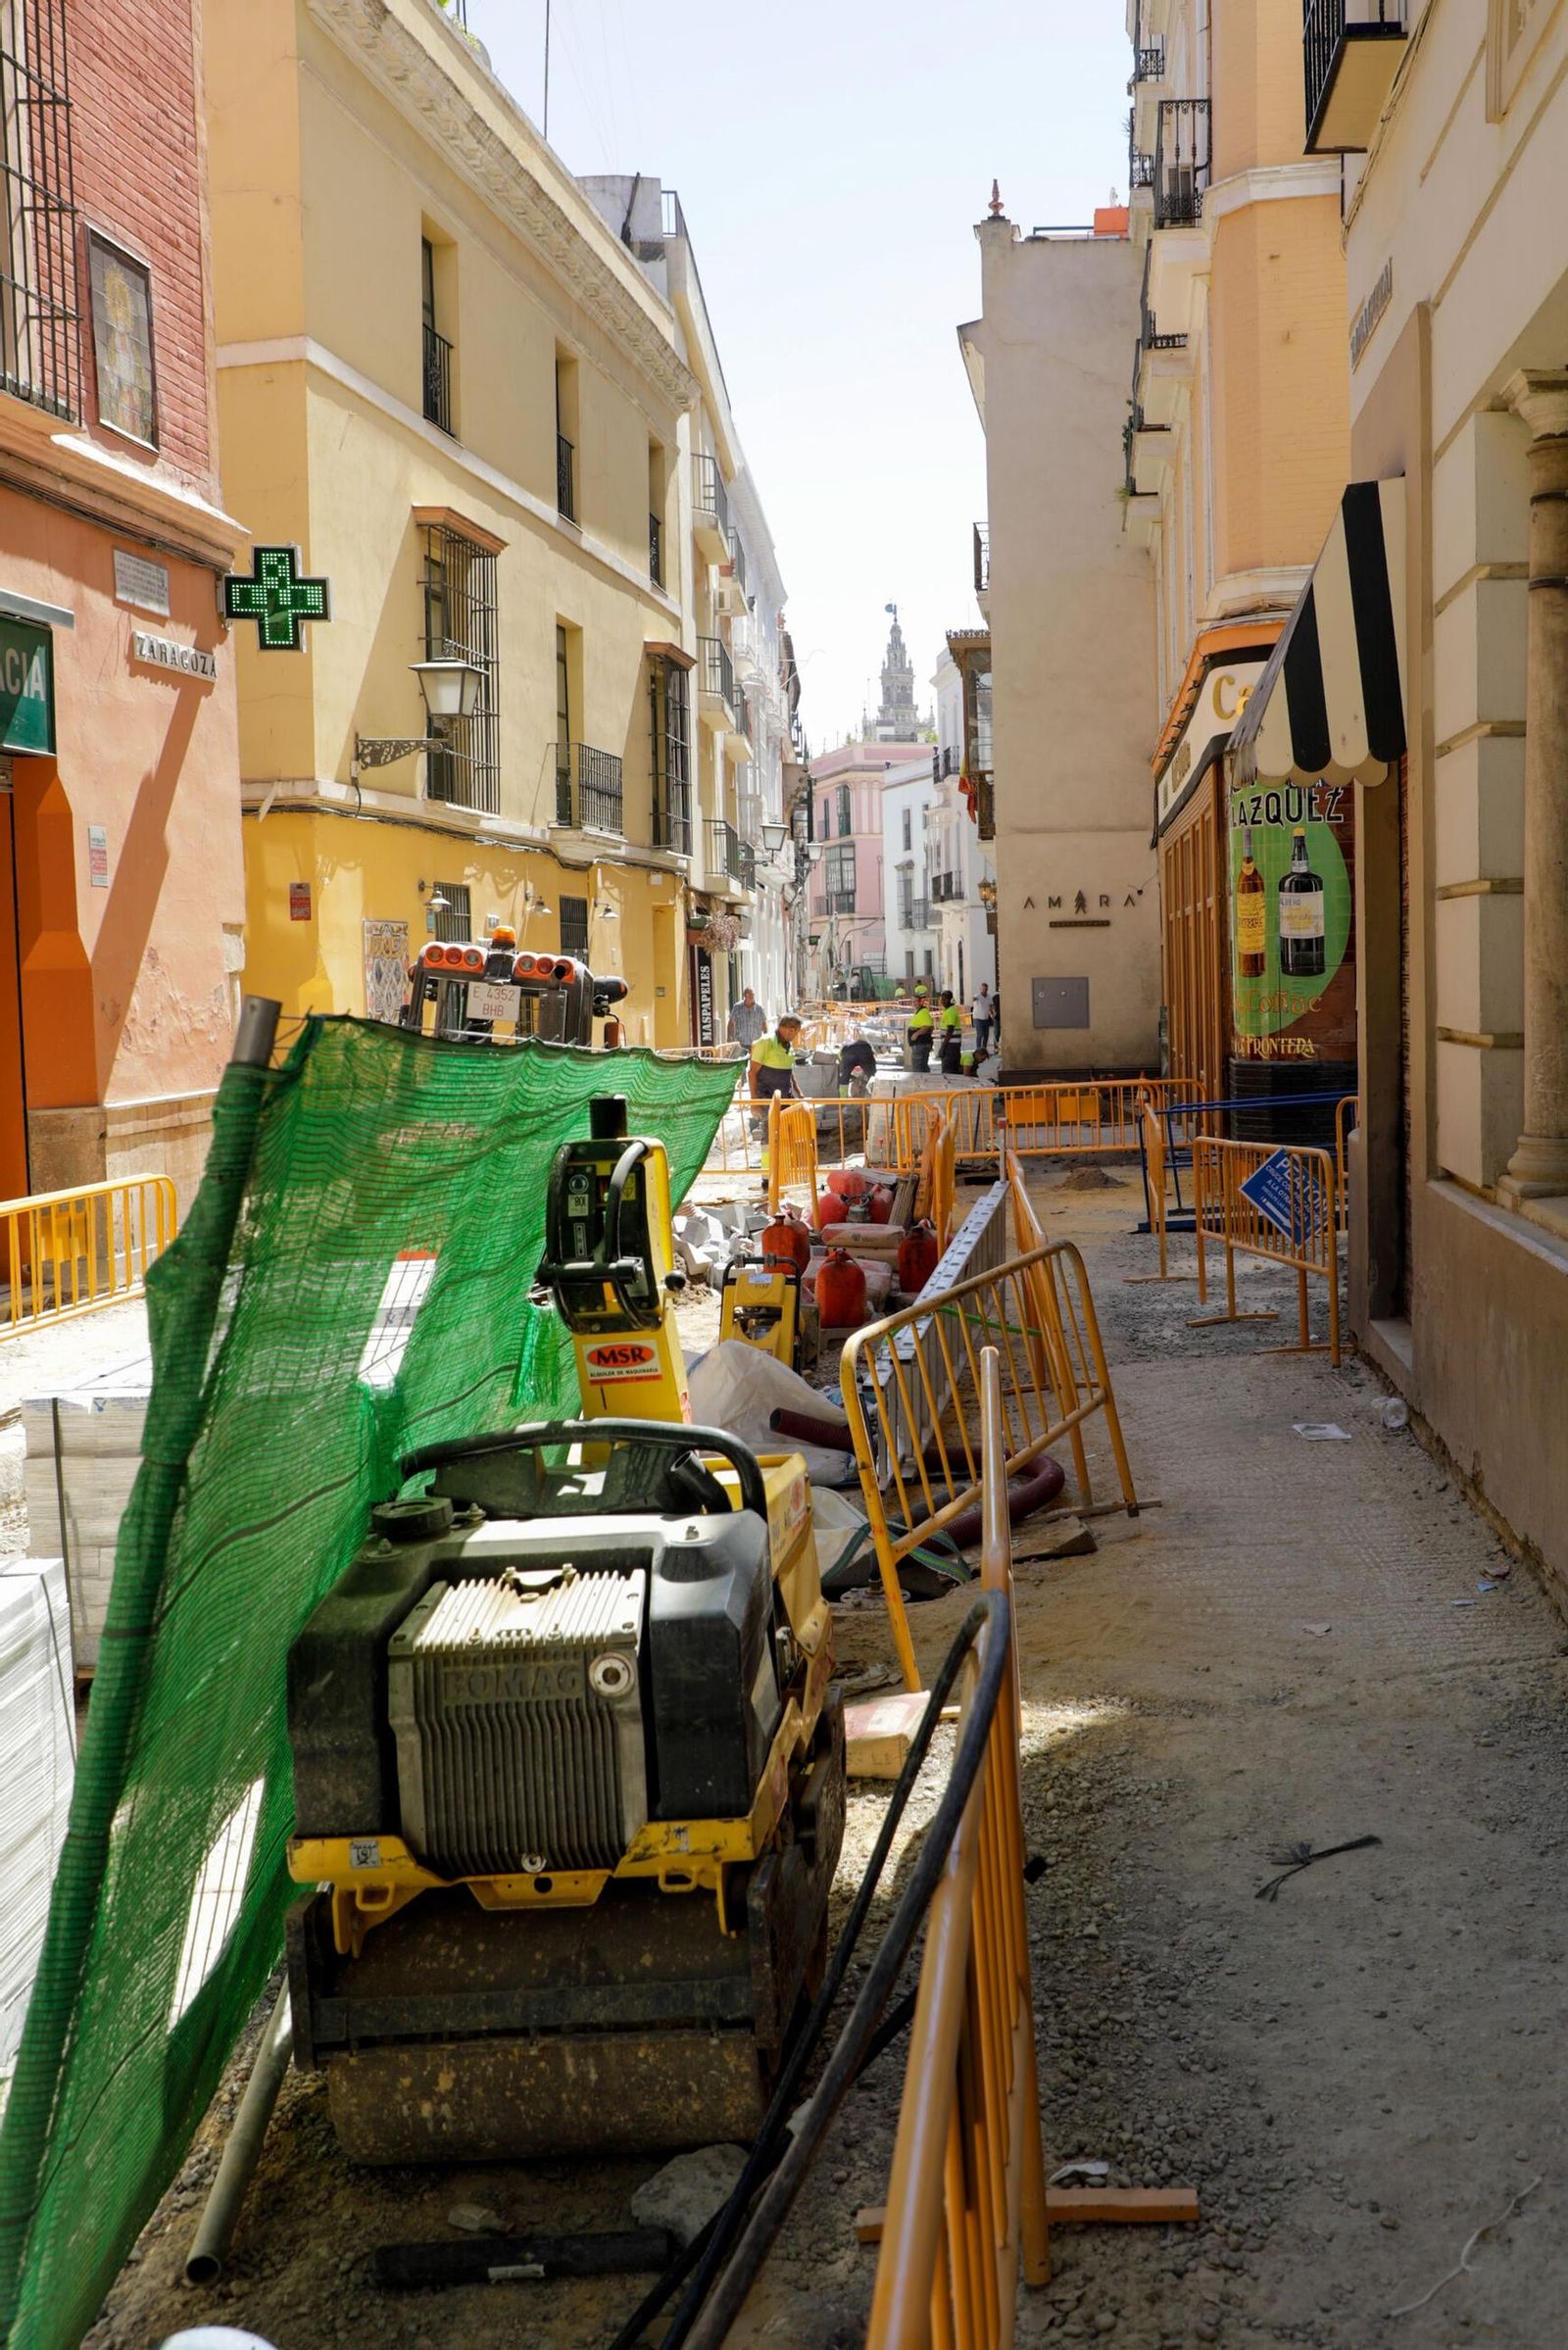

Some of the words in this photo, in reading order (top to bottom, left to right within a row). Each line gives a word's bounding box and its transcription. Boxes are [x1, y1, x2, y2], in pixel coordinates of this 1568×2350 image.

[136, 635, 218, 678] ZARAGOZA
[1023, 890, 1136, 914] AMARA
[472, 985, 481, 1000] E
[486, 988, 515, 1003] 4352
[482, 1004, 505, 1017] BHB
[597, 1346, 646, 1365] MSR
[444, 1663, 583, 1701] BOMAG
